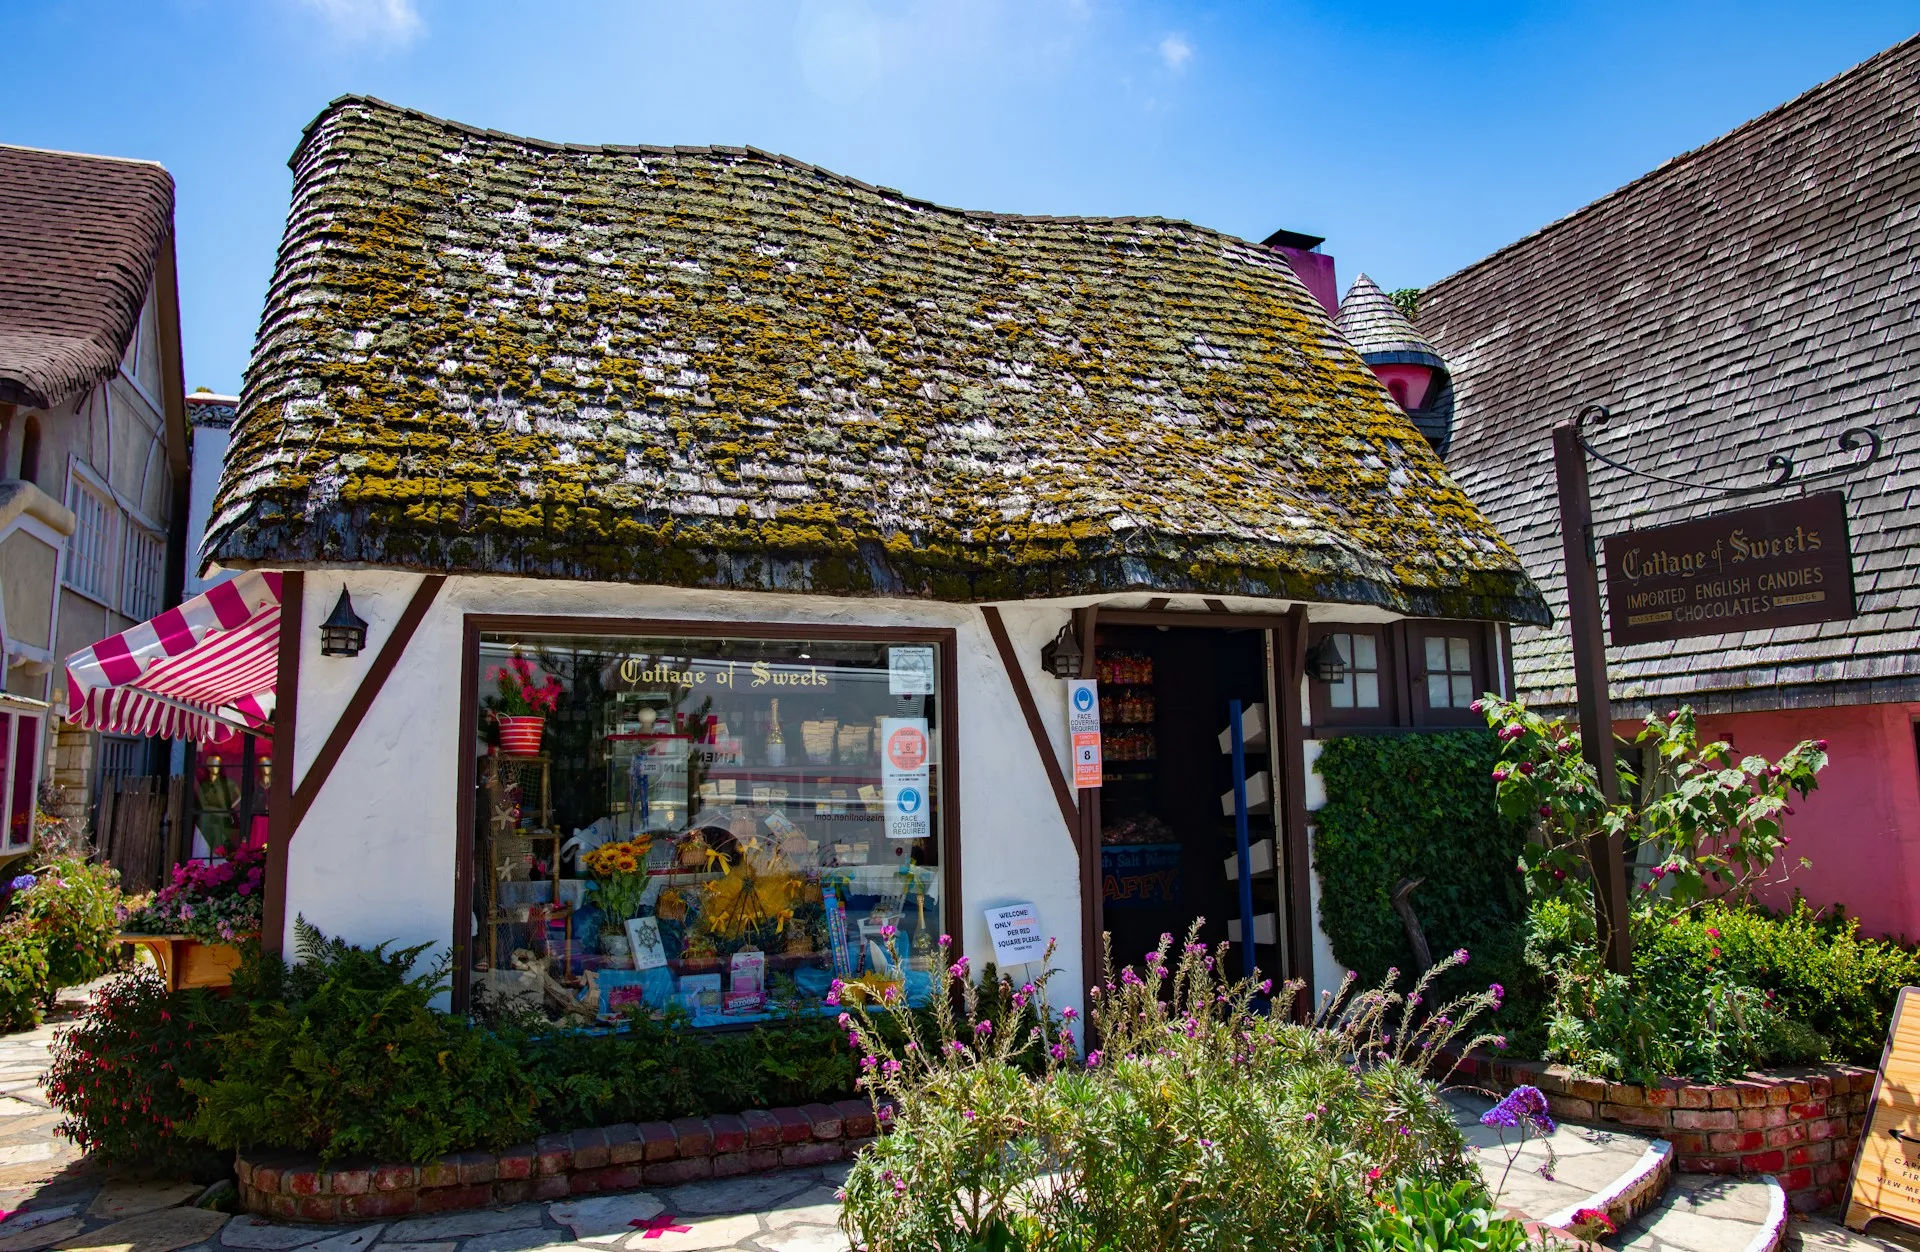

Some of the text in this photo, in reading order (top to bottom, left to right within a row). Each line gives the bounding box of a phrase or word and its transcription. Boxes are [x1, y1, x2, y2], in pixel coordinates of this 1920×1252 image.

[1622, 526, 1822, 586] Cottage of Sweets
[1627, 567, 1823, 609] IMPORTED ENGLISH CANDIES
[1631, 612, 1669, 623] CUSTOM
[1674, 596, 1771, 622] CHOCOLATES
[1786, 593, 1817, 603] FUDGE
[620, 657, 828, 689] Cottage of Sweets
[1084, 750, 1091, 760] 8
[1077, 765, 1099, 774] PEOPLE
[892, 821, 926, 829] COVERING
[1117, 854, 1140, 867] Salt
[1145, 852, 1179, 866] Water
[994, 921, 1012, 929] ONLY
[998, 938, 1022, 948] SQUARE
[728, 996, 761, 1009] Bazooka
[1877, 1176, 1901, 1188] VIEW
